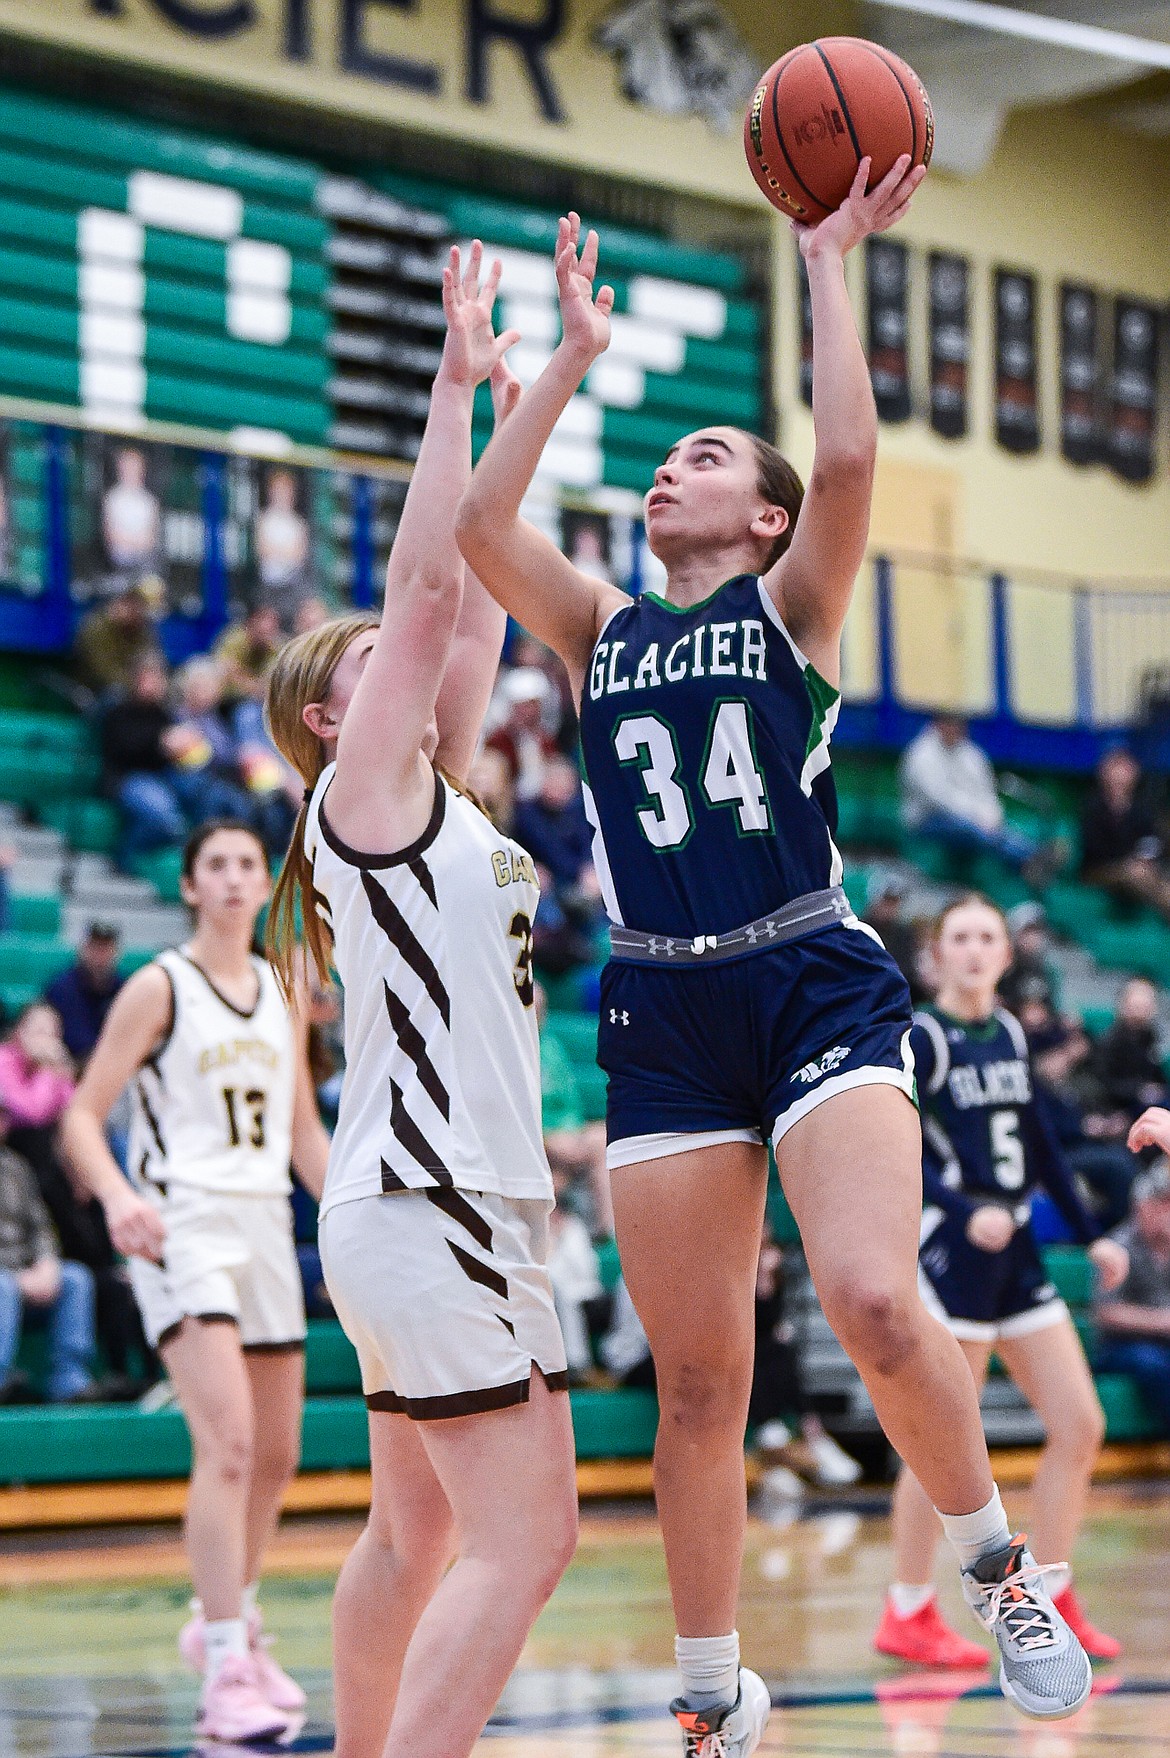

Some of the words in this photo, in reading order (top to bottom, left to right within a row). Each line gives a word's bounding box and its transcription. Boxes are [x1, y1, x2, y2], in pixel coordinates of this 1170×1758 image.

[589, 619, 769, 701] GLACIER
[611, 697, 776, 854] 34
[222, 1087, 266, 1150] 13
[989, 1109, 1025, 1191] 5
